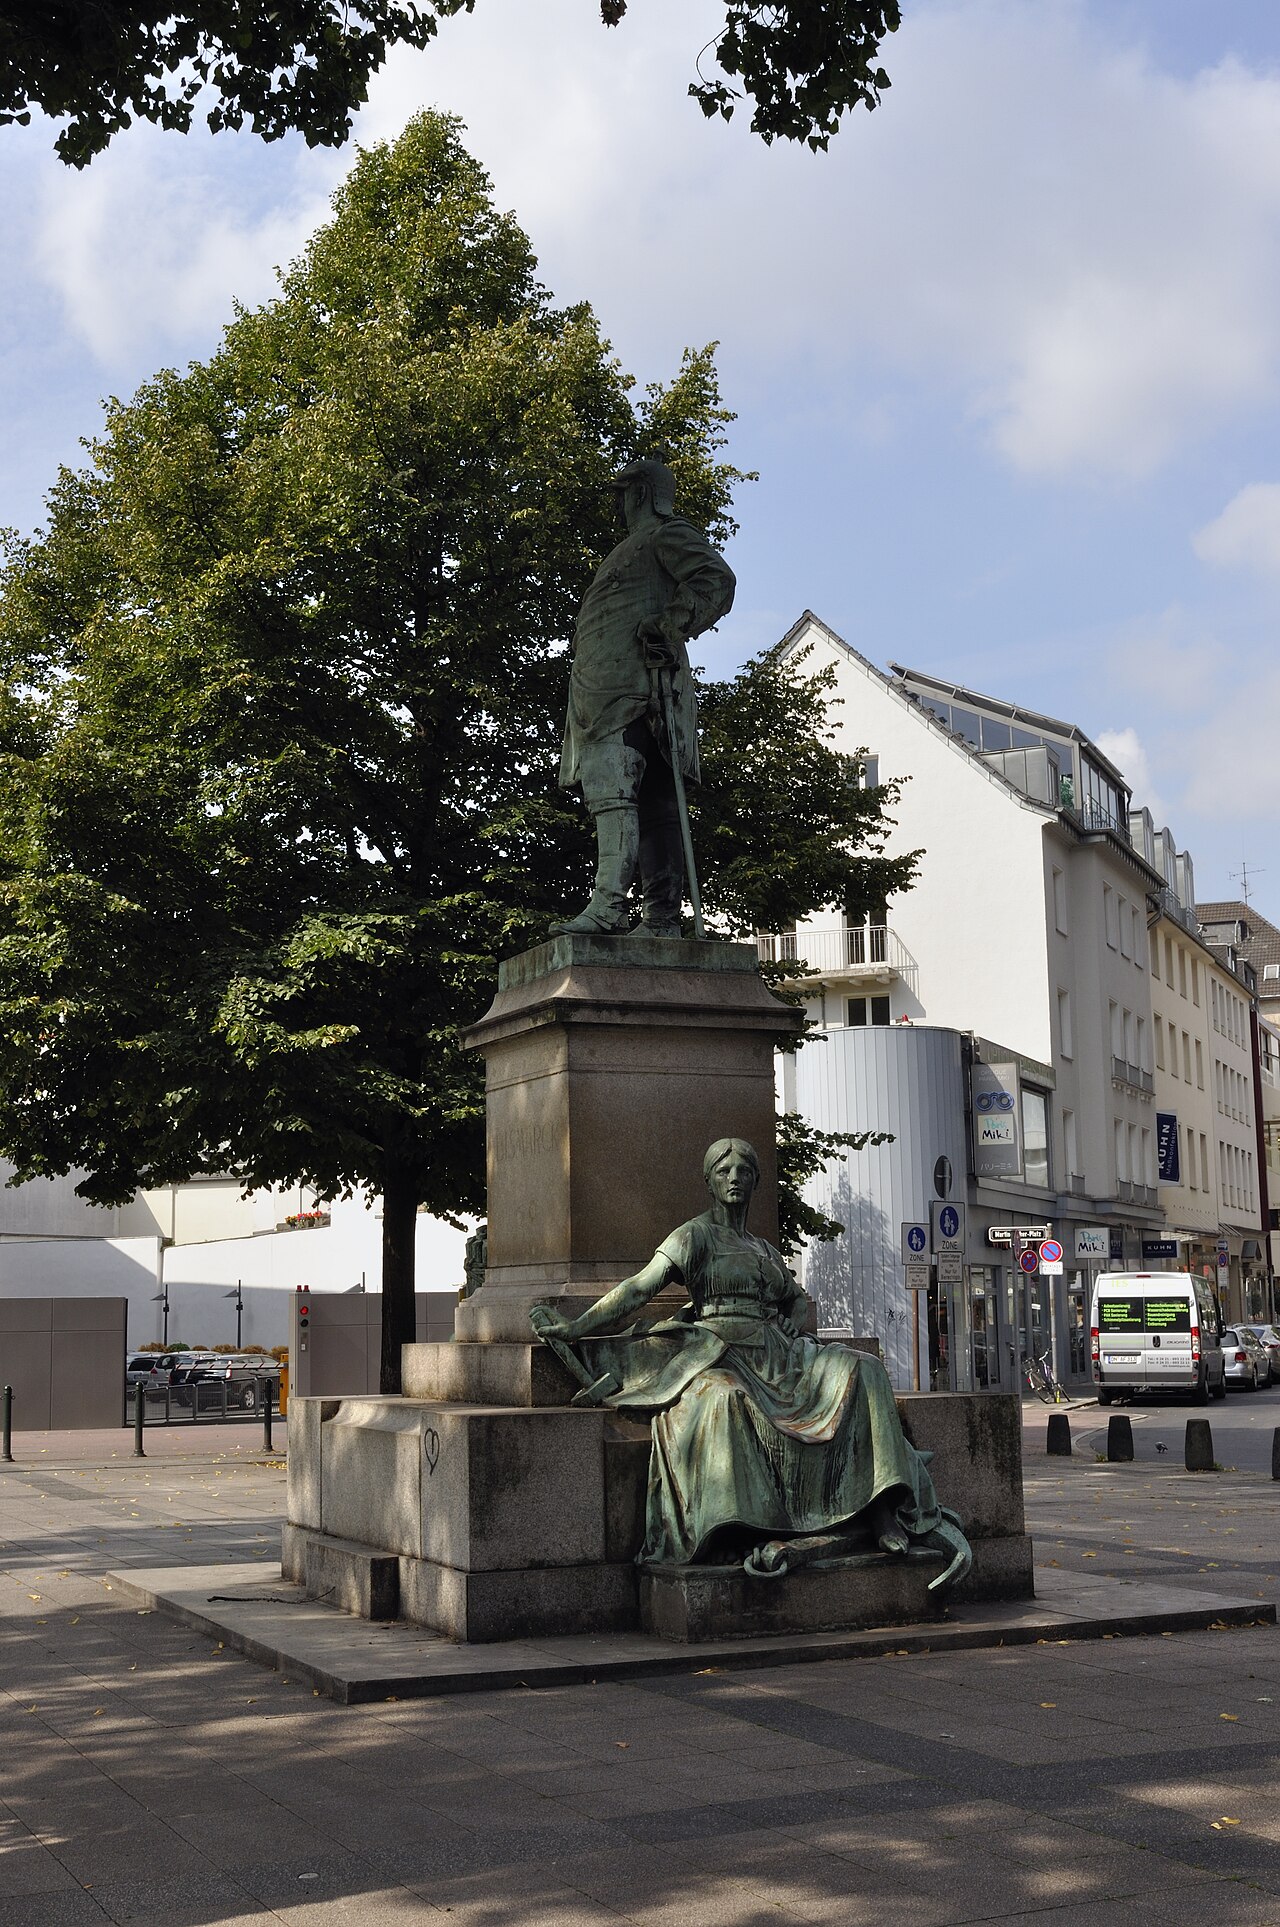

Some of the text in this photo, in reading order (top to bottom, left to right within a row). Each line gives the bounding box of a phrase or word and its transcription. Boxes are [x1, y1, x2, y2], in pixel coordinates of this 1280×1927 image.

[983, 1118, 1007, 1130] Paris
[982, 1129, 1012, 1141] Miki
[1159, 1124, 1171, 1169] KUHN
[1165, 1122, 1178, 1175] Maßkonfektion
[1080, 1231, 1103, 1243] Paris
[941, 1240, 958, 1250] ZONE
[1078, 1242, 1107, 1253] Miki
[909, 1253, 925, 1262] ZONE
